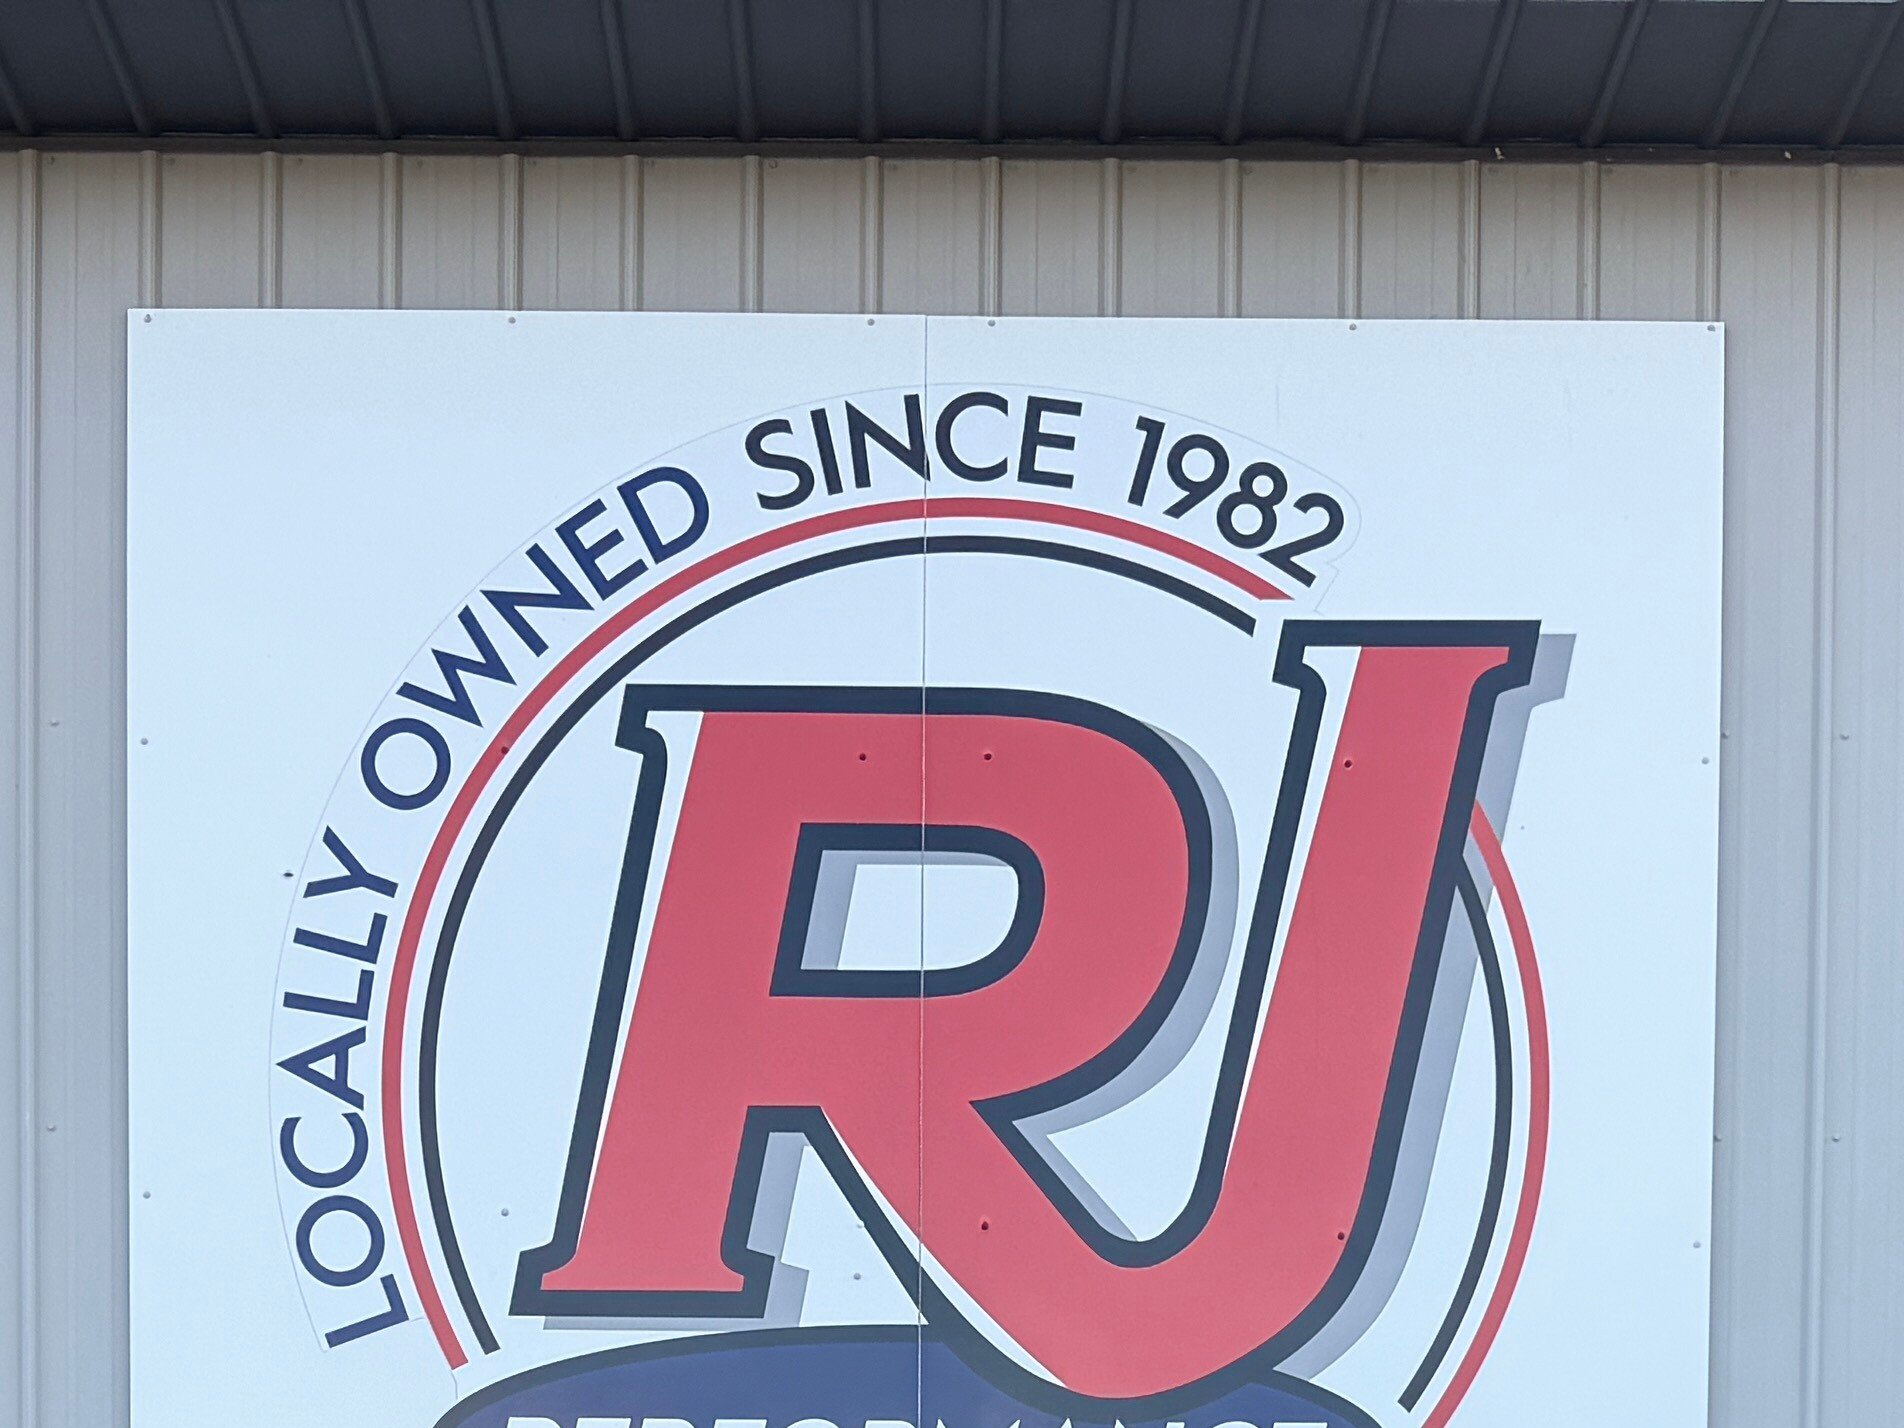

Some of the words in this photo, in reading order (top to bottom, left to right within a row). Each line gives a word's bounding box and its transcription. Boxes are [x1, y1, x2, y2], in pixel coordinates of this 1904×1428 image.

[275, 824, 410, 1348] LOCALLY
[360, 465, 710, 811] OWNED
[744, 391, 1083, 511] SINCE
[1126, 415, 1345, 588] 1982
[509, 619, 1542, 1416] RJ
